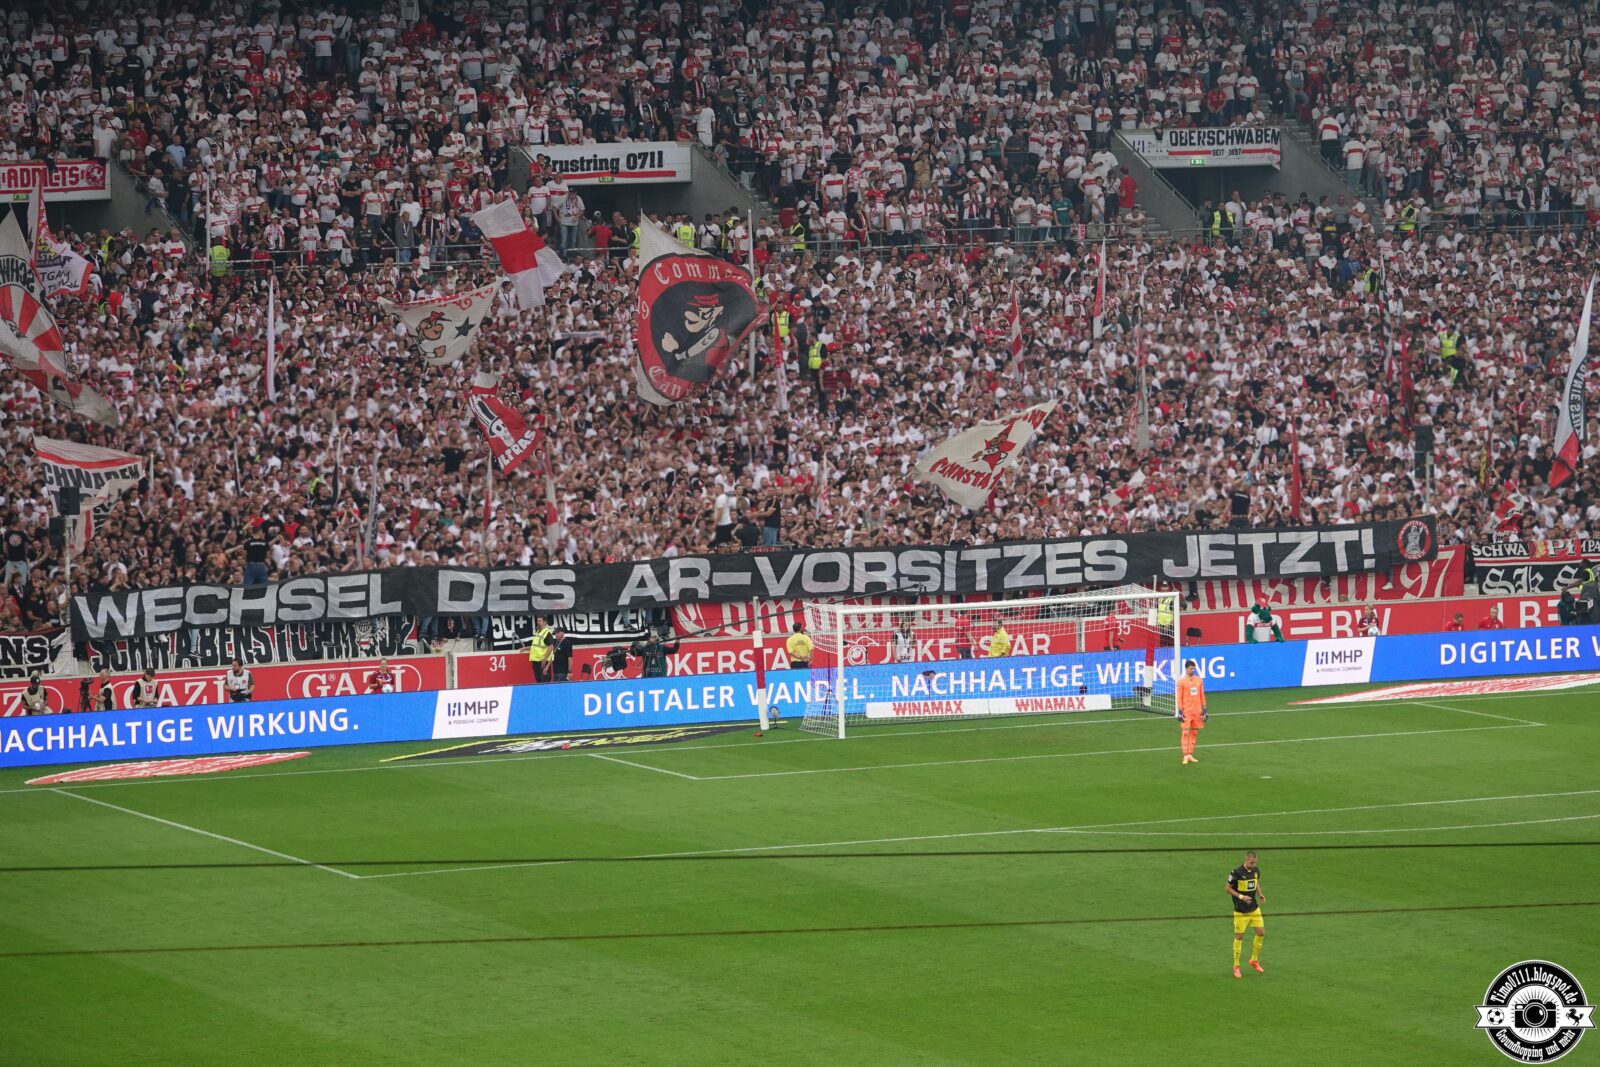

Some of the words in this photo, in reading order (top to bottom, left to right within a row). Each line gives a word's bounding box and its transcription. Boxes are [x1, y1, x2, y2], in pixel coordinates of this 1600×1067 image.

[1169, 128, 1280, 146] OBERSCHWABEN
[626, 150, 663, 170] 0711
[74, 572, 402, 638] WECHSEL
[438, 569, 576, 612] DES
[617, 539, 1128, 605] AR-VORSITZES
[1162, 528, 1376, 578] JETZT!
[1331, 650, 1363, 664] MHP
[1440, 637, 1581, 666] DIGITALER
[489, 656, 507, 672] 34
[583, 685, 735, 717] DIGITALER
[892, 664, 1085, 698] NACHHALTIGE
[464, 700, 499, 715] MHP
[893, 701, 963, 716] WINAMAX
[1015, 697, 1086, 713] WINAMAX
[208, 708, 359, 740] WIRKUNG.
